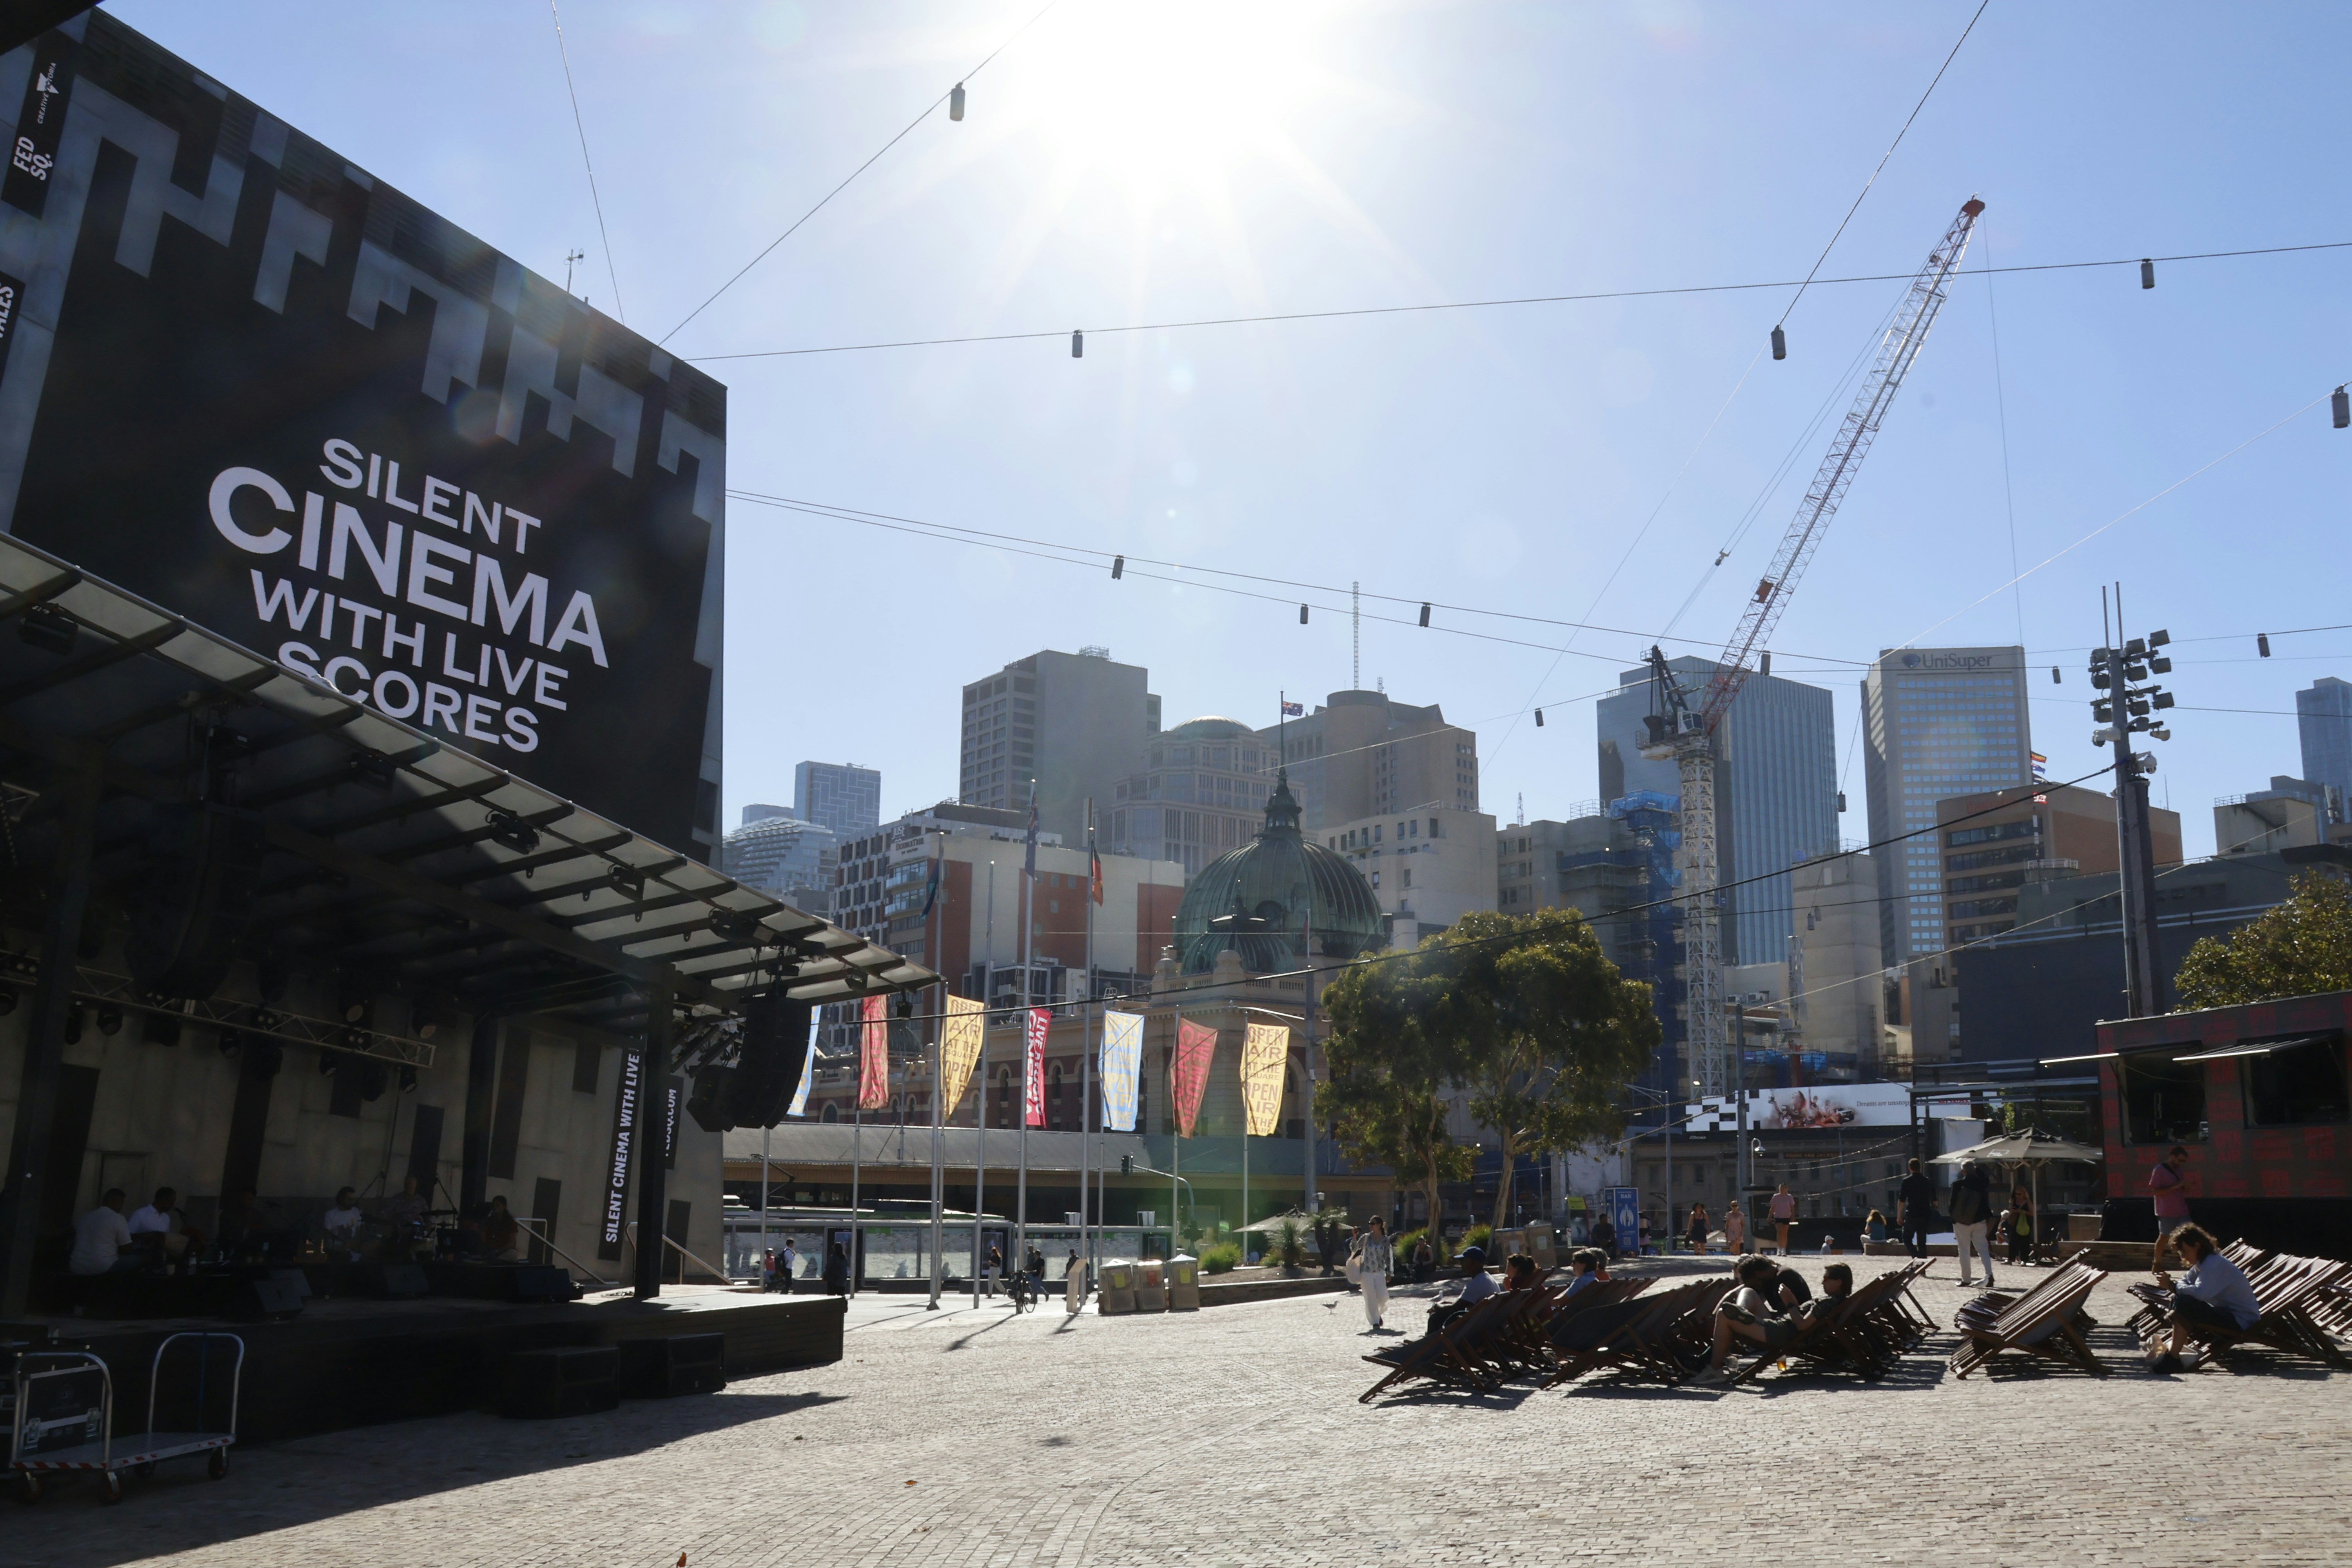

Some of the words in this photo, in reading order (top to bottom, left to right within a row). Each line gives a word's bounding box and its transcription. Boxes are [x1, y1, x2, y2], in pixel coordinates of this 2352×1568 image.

[13, 136, 34, 172] FED
[30, 153, 53, 181] SQ.
[319, 439, 541, 554] SILENT
[209, 467, 609, 668] CINEMA
[250, 569, 425, 668] WITH
[443, 632, 569, 711] LIVE
[1922, 653, 1992, 671] UniSuper
[278, 642, 539, 753] SCORES
[950, 999, 984, 1024] OPEN
[1105, 1013, 1140, 1035] OPEN
[948, 1020, 980, 1038] AIR
[1034, 1016, 1047, 1049] LIVE
[1105, 1033, 1137, 1050] AIR
[1247, 1026, 1284, 1046] OPEN
[1192, 1033, 1213, 1064] LIVE
[1247, 1045, 1282, 1060] AIR
[626, 1053, 640, 1087] LIVE
[1247, 1062, 1258, 1071] AT
[1261, 1063, 1280, 1074] THE
[1181, 1065, 1206, 1129] MUSIC
[1245, 1082, 1278, 1102] OPEN
[620, 1090, 635, 1127] WITH
[612, 1132, 630, 1187] CINEMA
[606, 1190, 622, 1243] SILENT
